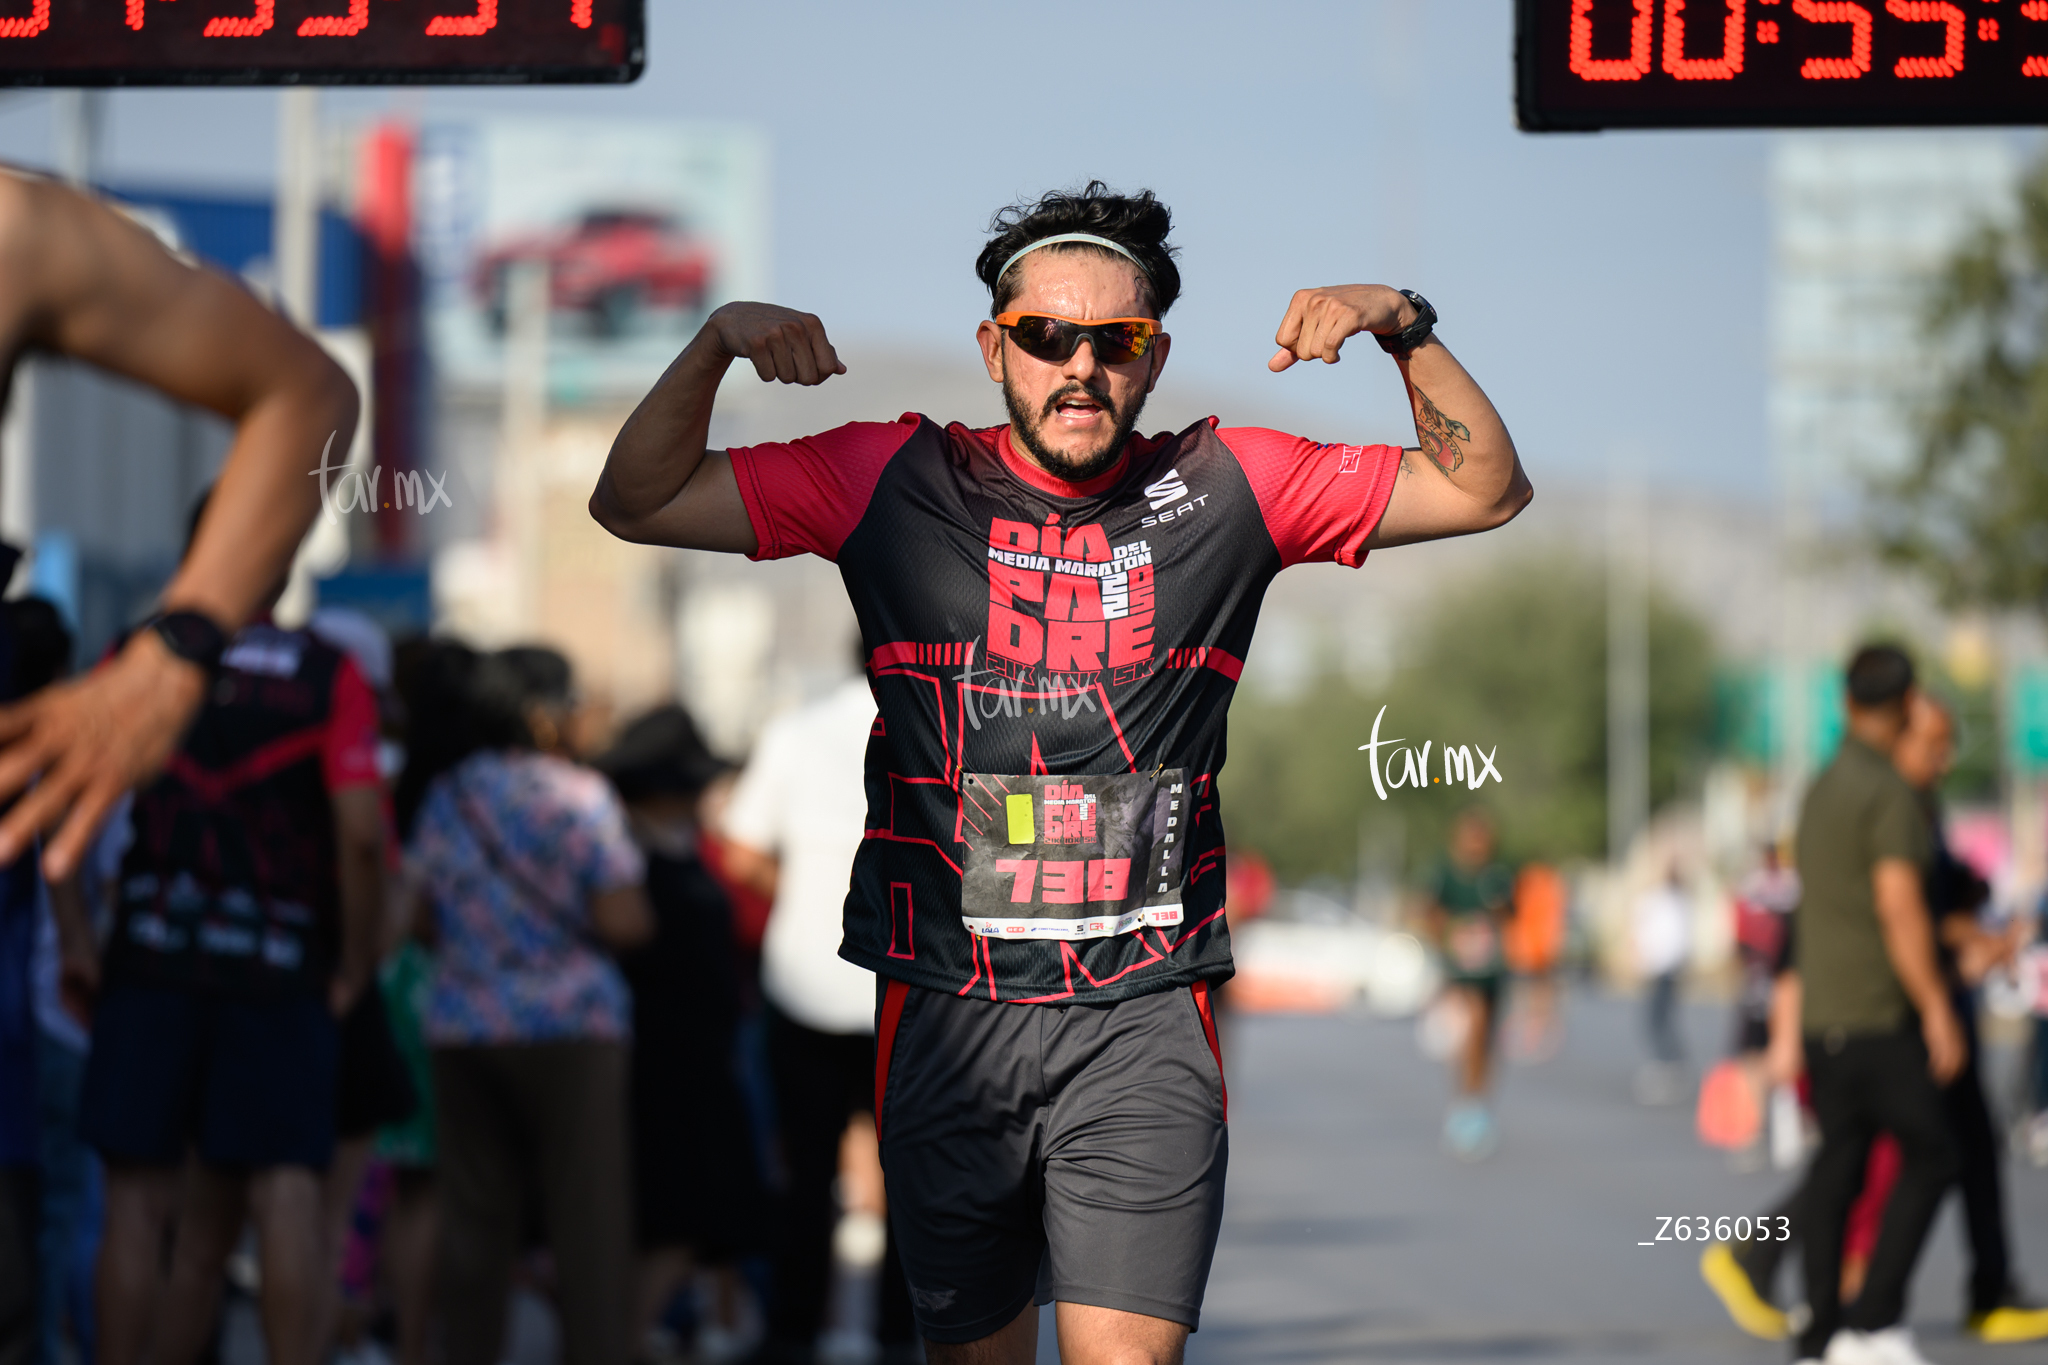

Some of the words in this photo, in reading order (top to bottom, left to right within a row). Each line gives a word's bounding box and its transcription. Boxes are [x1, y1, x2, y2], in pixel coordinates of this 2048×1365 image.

[1141, 494, 1209, 529] SEAT
[988, 546, 1050, 571] MEDIA
[1113, 540, 1152, 560] DEL
[986, 651, 1035, 686] 21K
[1113, 657, 1155, 686] 5K
[1157, 783, 1183, 893] MEDALLA
[995, 857, 1132, 904] 738
[1152, 910, 1179, 921] 738
